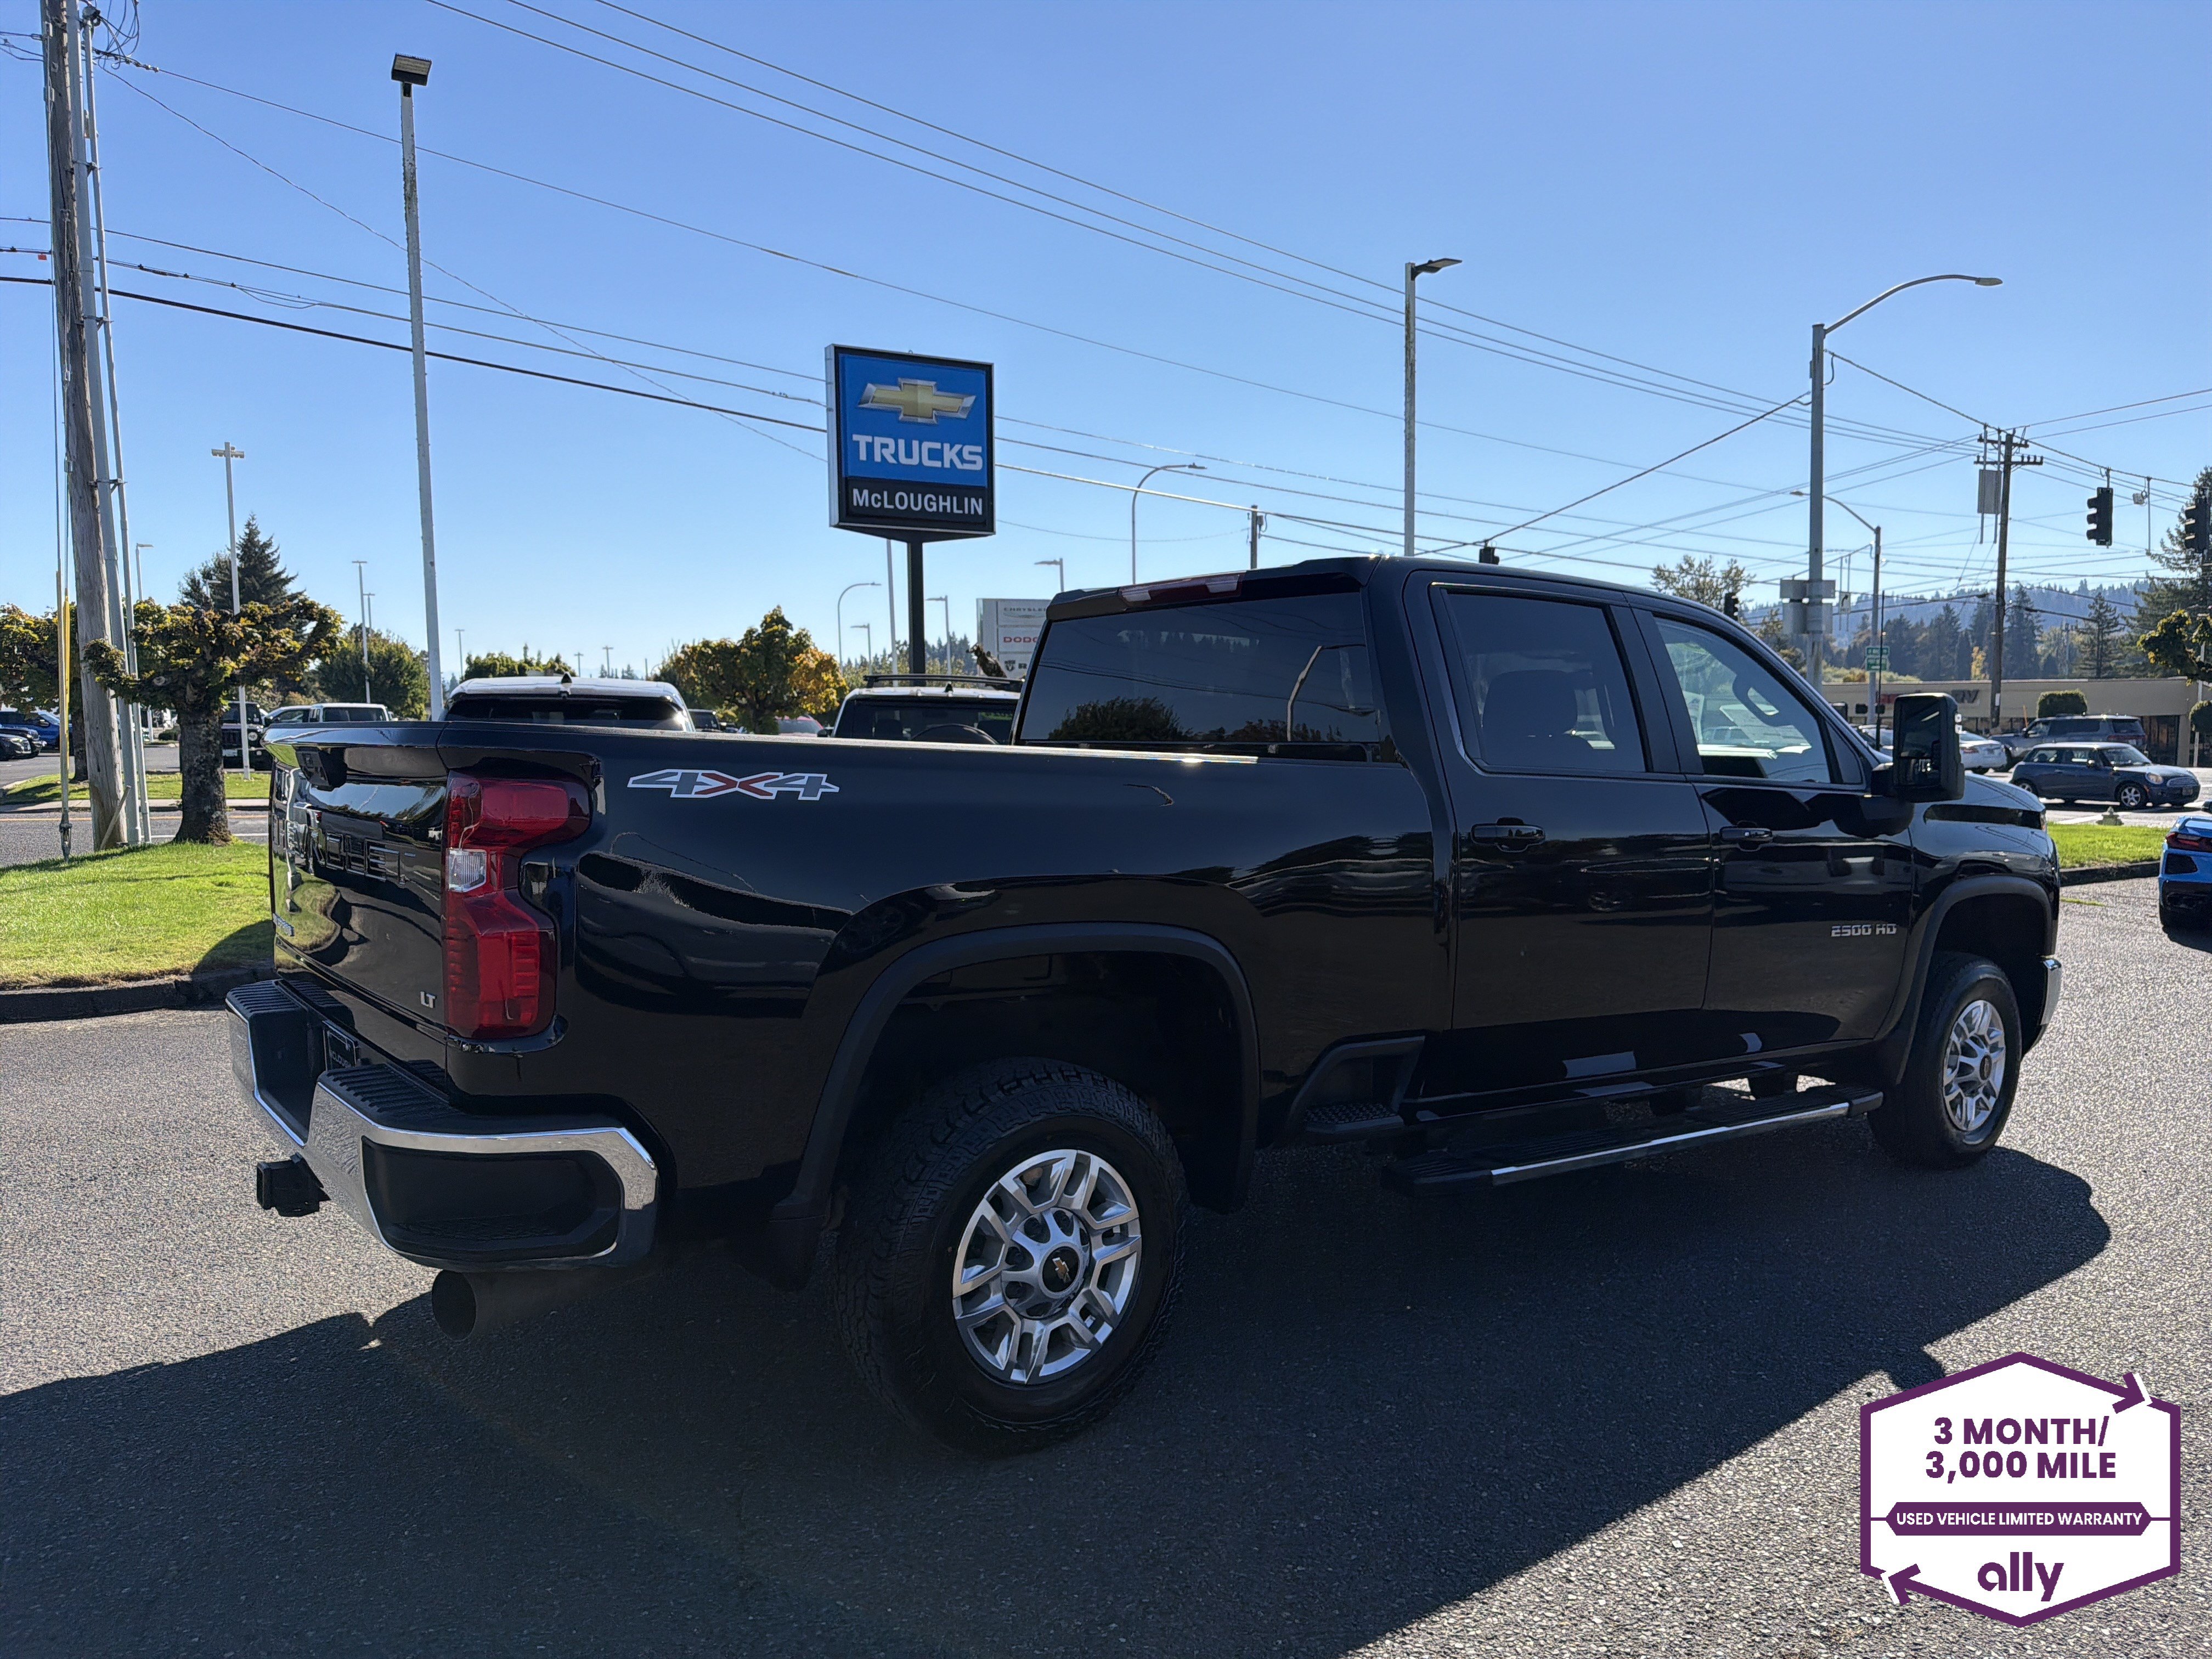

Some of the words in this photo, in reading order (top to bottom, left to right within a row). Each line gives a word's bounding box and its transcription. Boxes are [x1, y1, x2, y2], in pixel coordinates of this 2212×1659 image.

[853, 434, 983, 471] TRUCKS
[853, 488, 983, 515] McLOUGHLIN
[1831, 924, 1872, 937] 2500
[1875, 923, 1897, 935] HD
[420, 991, 436, 1008] LT
